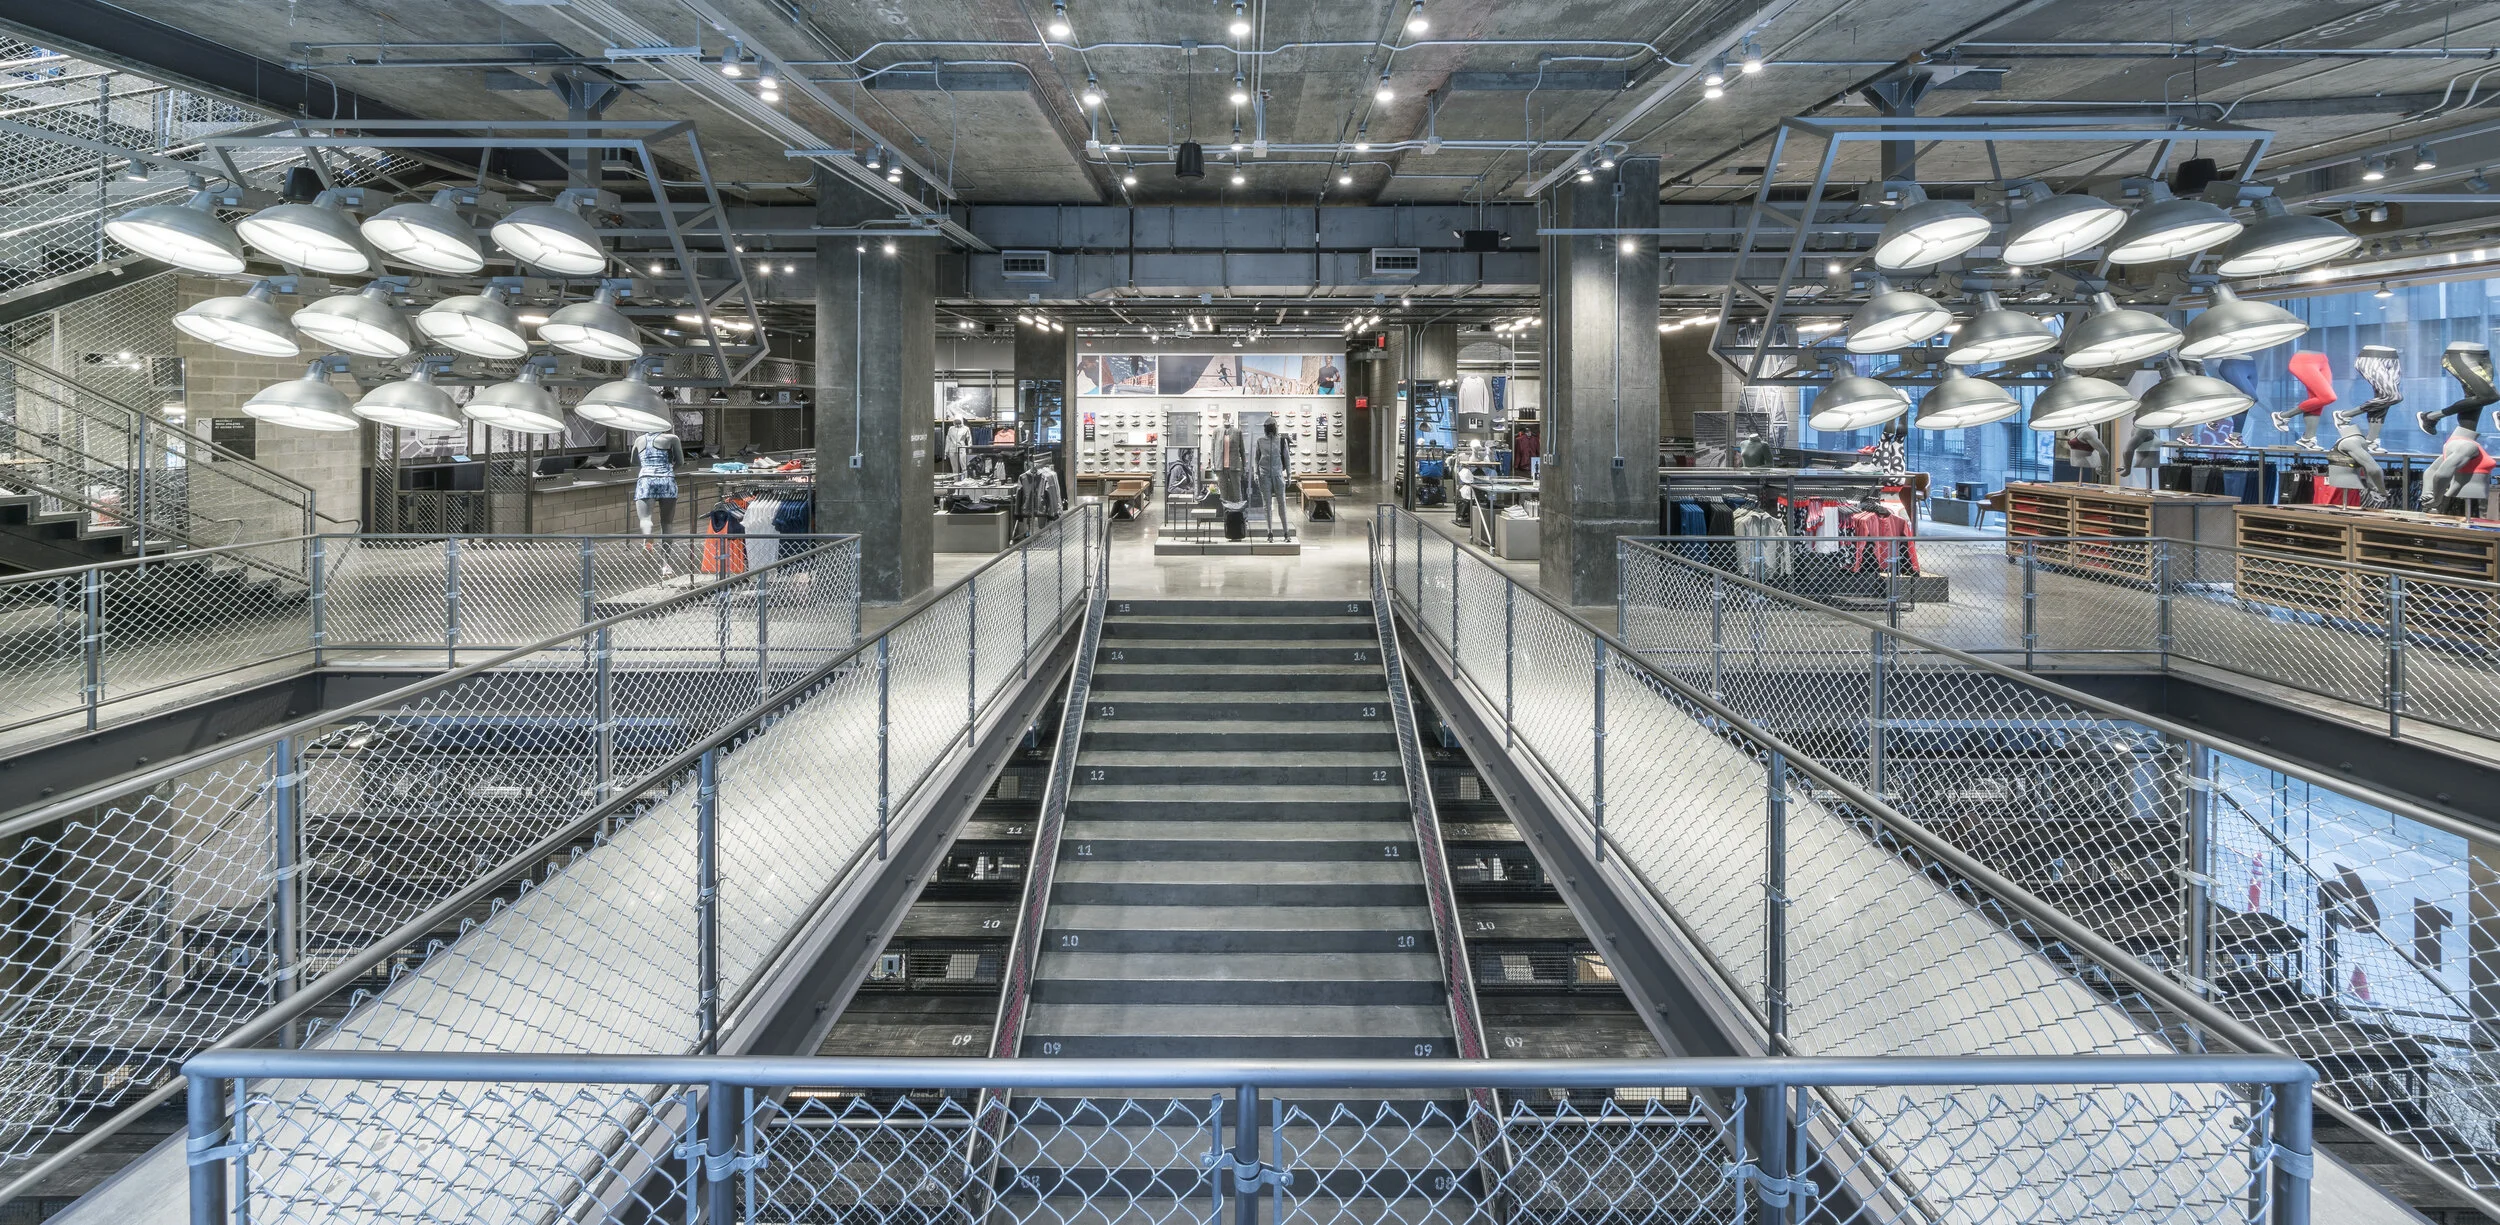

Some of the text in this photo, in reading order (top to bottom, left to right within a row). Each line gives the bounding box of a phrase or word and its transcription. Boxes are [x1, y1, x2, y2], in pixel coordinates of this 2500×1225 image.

[1120, 604, 1130, 612] 15
[1348, 604, 1358, 612] 15
[1112, 652, 1123, 660] 14
[1354, 652, 1366, 660] 14
[1102, 707, 1114, 716] 13
[1363, 707, 1375, 716] 13
[1091, 771, 1104, 780] 12
[1373, 771, 1386, 781] 12
[1078, 845, 1092, 855] 11
[1385, 846, 1399, 856] 11
[983, 920, 1000, 928] 10
[1477, 922, 1495, 930] 10
[1063, 936, 1078, 946] 10
[1398, 936, 1414, 947] 10
[952, 1035, 971, 1045] 09
[1505, 1037, 1522, 1047] 09
[1044, 1042, 1061, 1054] 09
[1415, 1044, 1432, 1056] 09
[1434, 1176, 1455, 1190] 08
